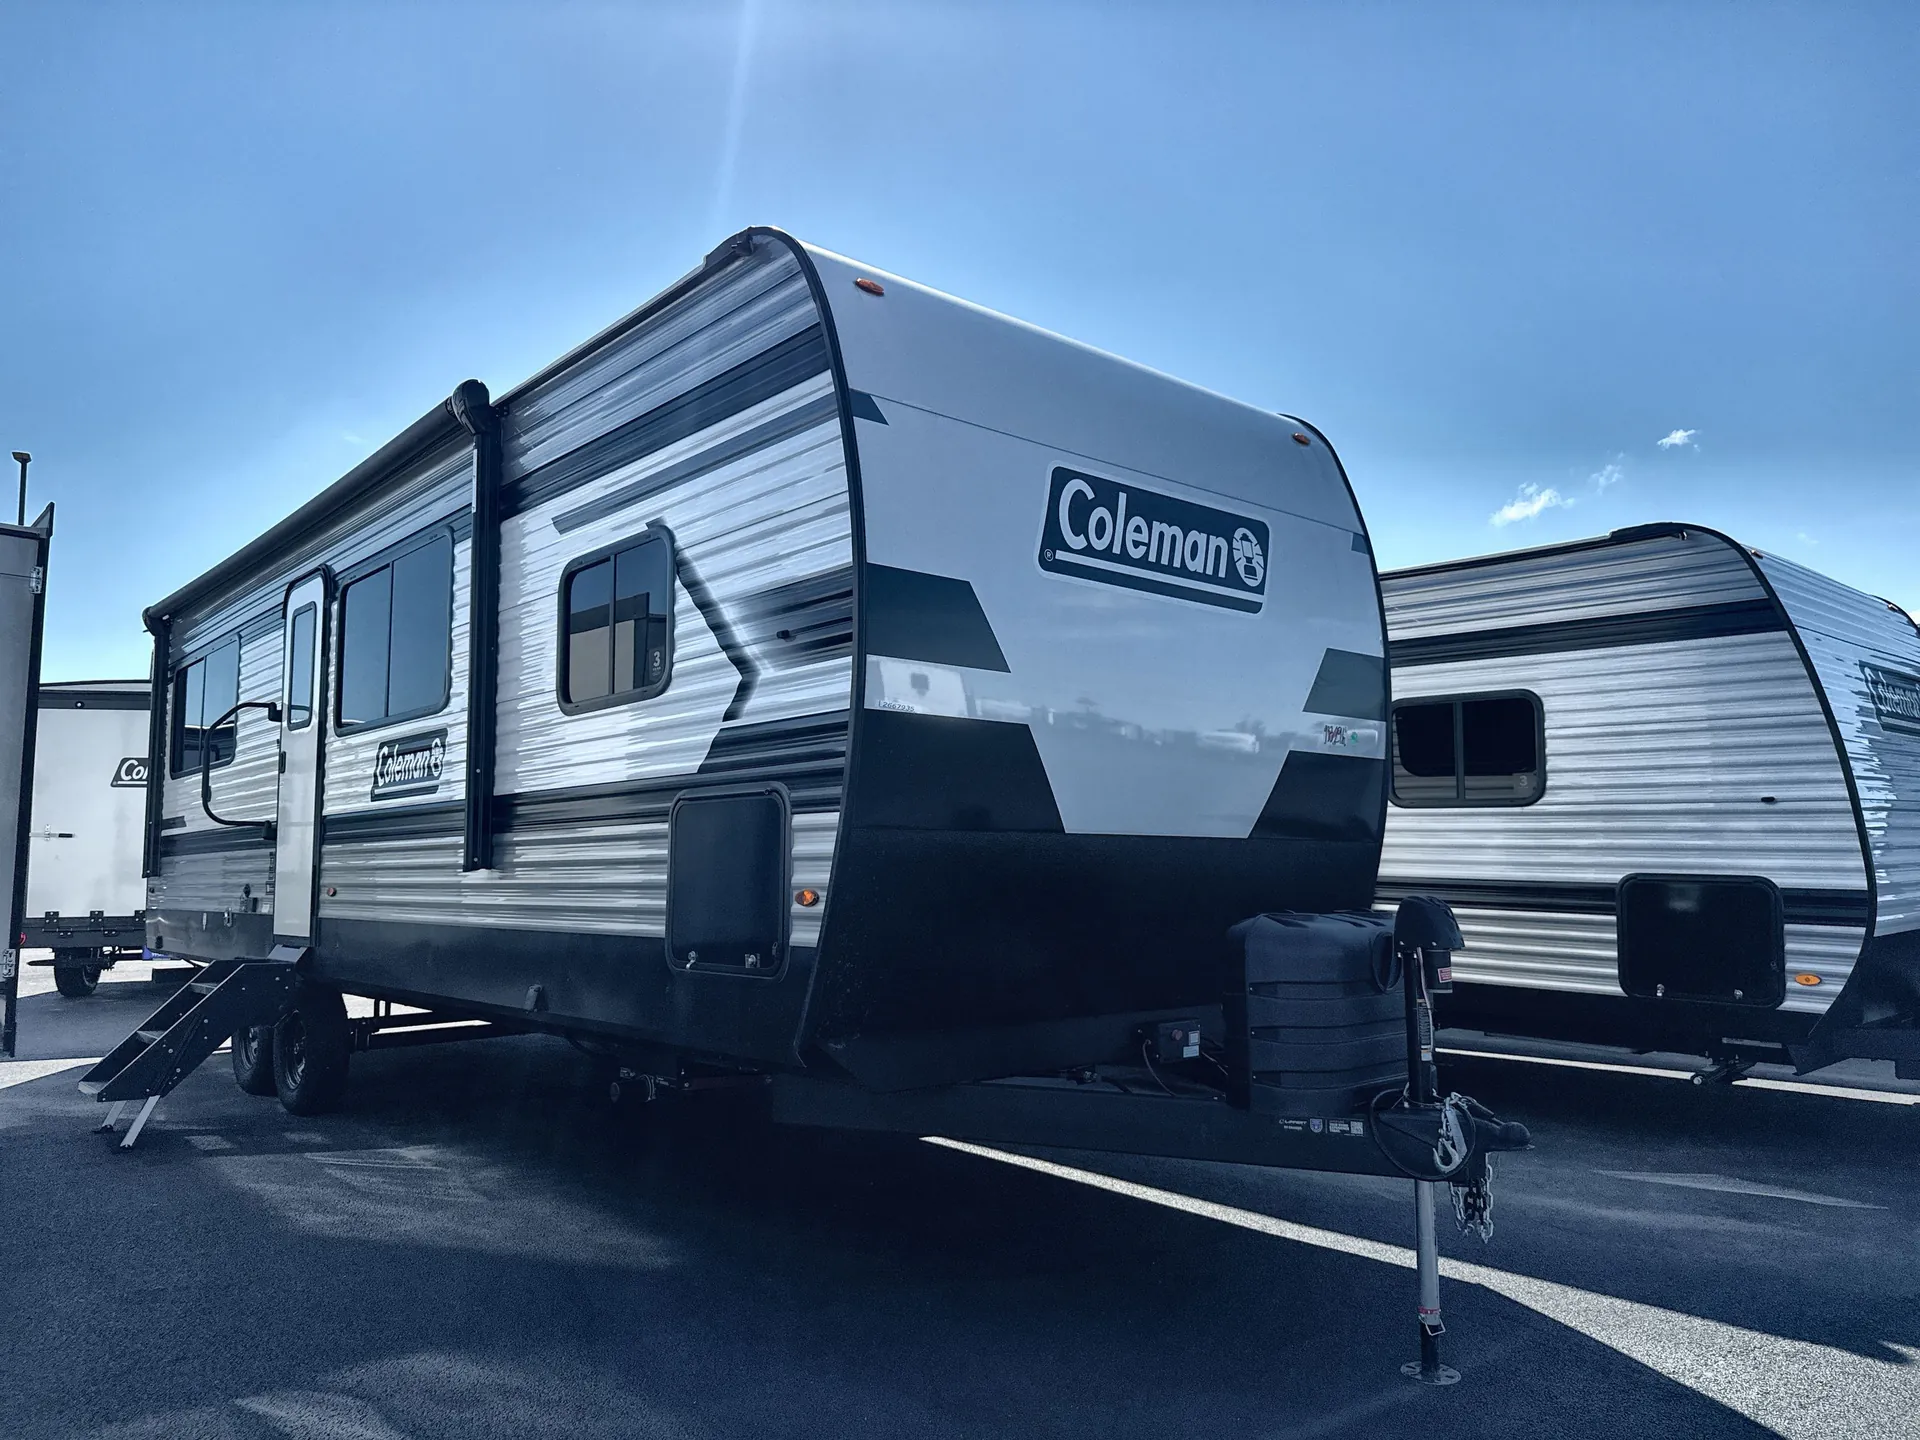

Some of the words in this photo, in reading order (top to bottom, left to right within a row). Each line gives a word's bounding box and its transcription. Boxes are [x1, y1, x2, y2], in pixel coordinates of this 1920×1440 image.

[1058, 478, 1228, 578] Coleman
[653, 651, 661, 667] 3
[376, 744, 431, 787] Coleman
